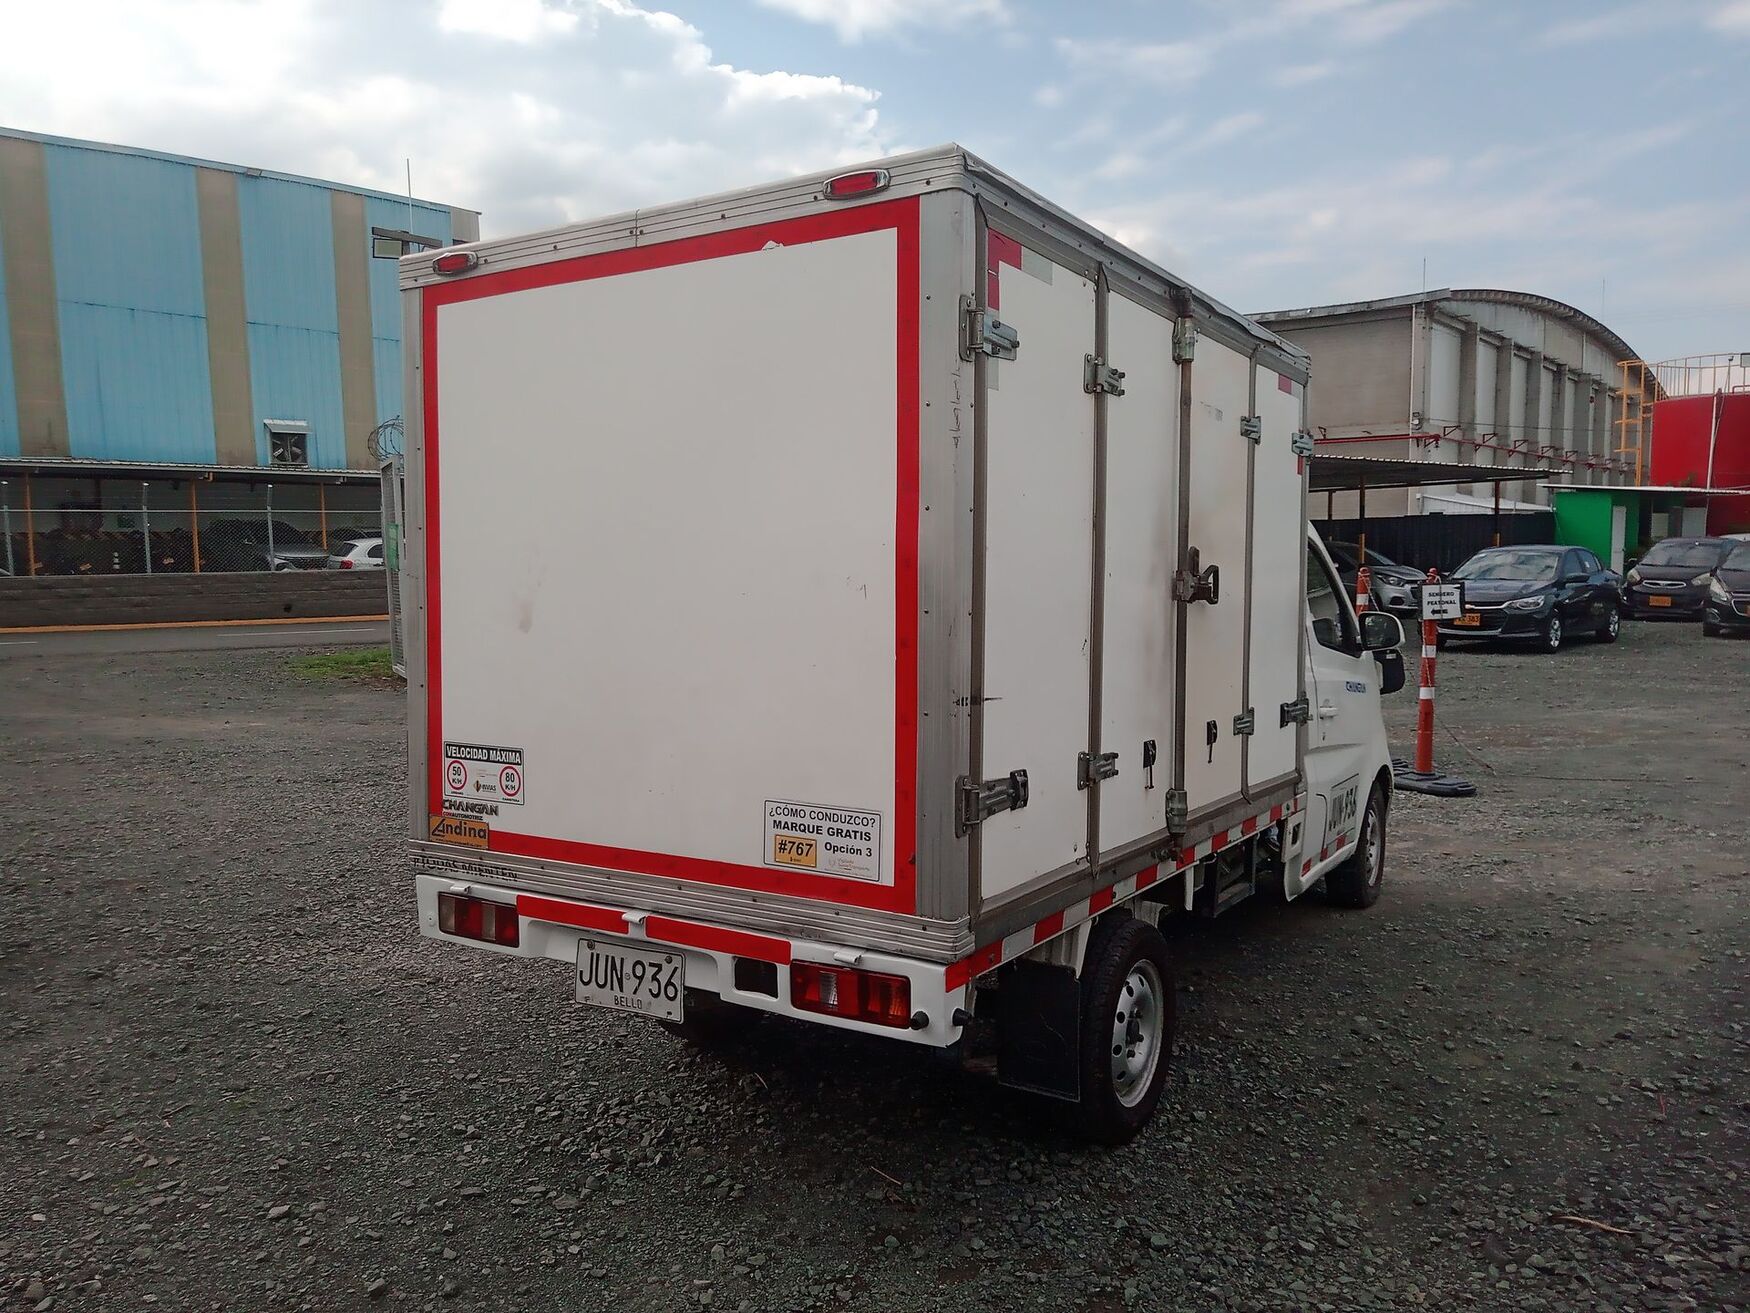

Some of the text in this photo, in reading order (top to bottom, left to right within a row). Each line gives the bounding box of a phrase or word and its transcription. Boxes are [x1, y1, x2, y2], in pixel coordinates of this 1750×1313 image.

[446, 745, 488, 760] VELOCIDAD
[452, 766, 462, 776] 50
[505, 772, 515, 783] 80
[443, 799, 499, 816] CHANGAN
[769, 804, 876, 828] ¿CÓMO CONDUZCO?
[432, 818, 487, 839] Andina
[772, 819, 871, 841] MARQUE GRATIS
[778, 839, 813, 857] #767
[824, 842, 872, 857] Opción 3
[614, 995, 642, 1009] BELLO
